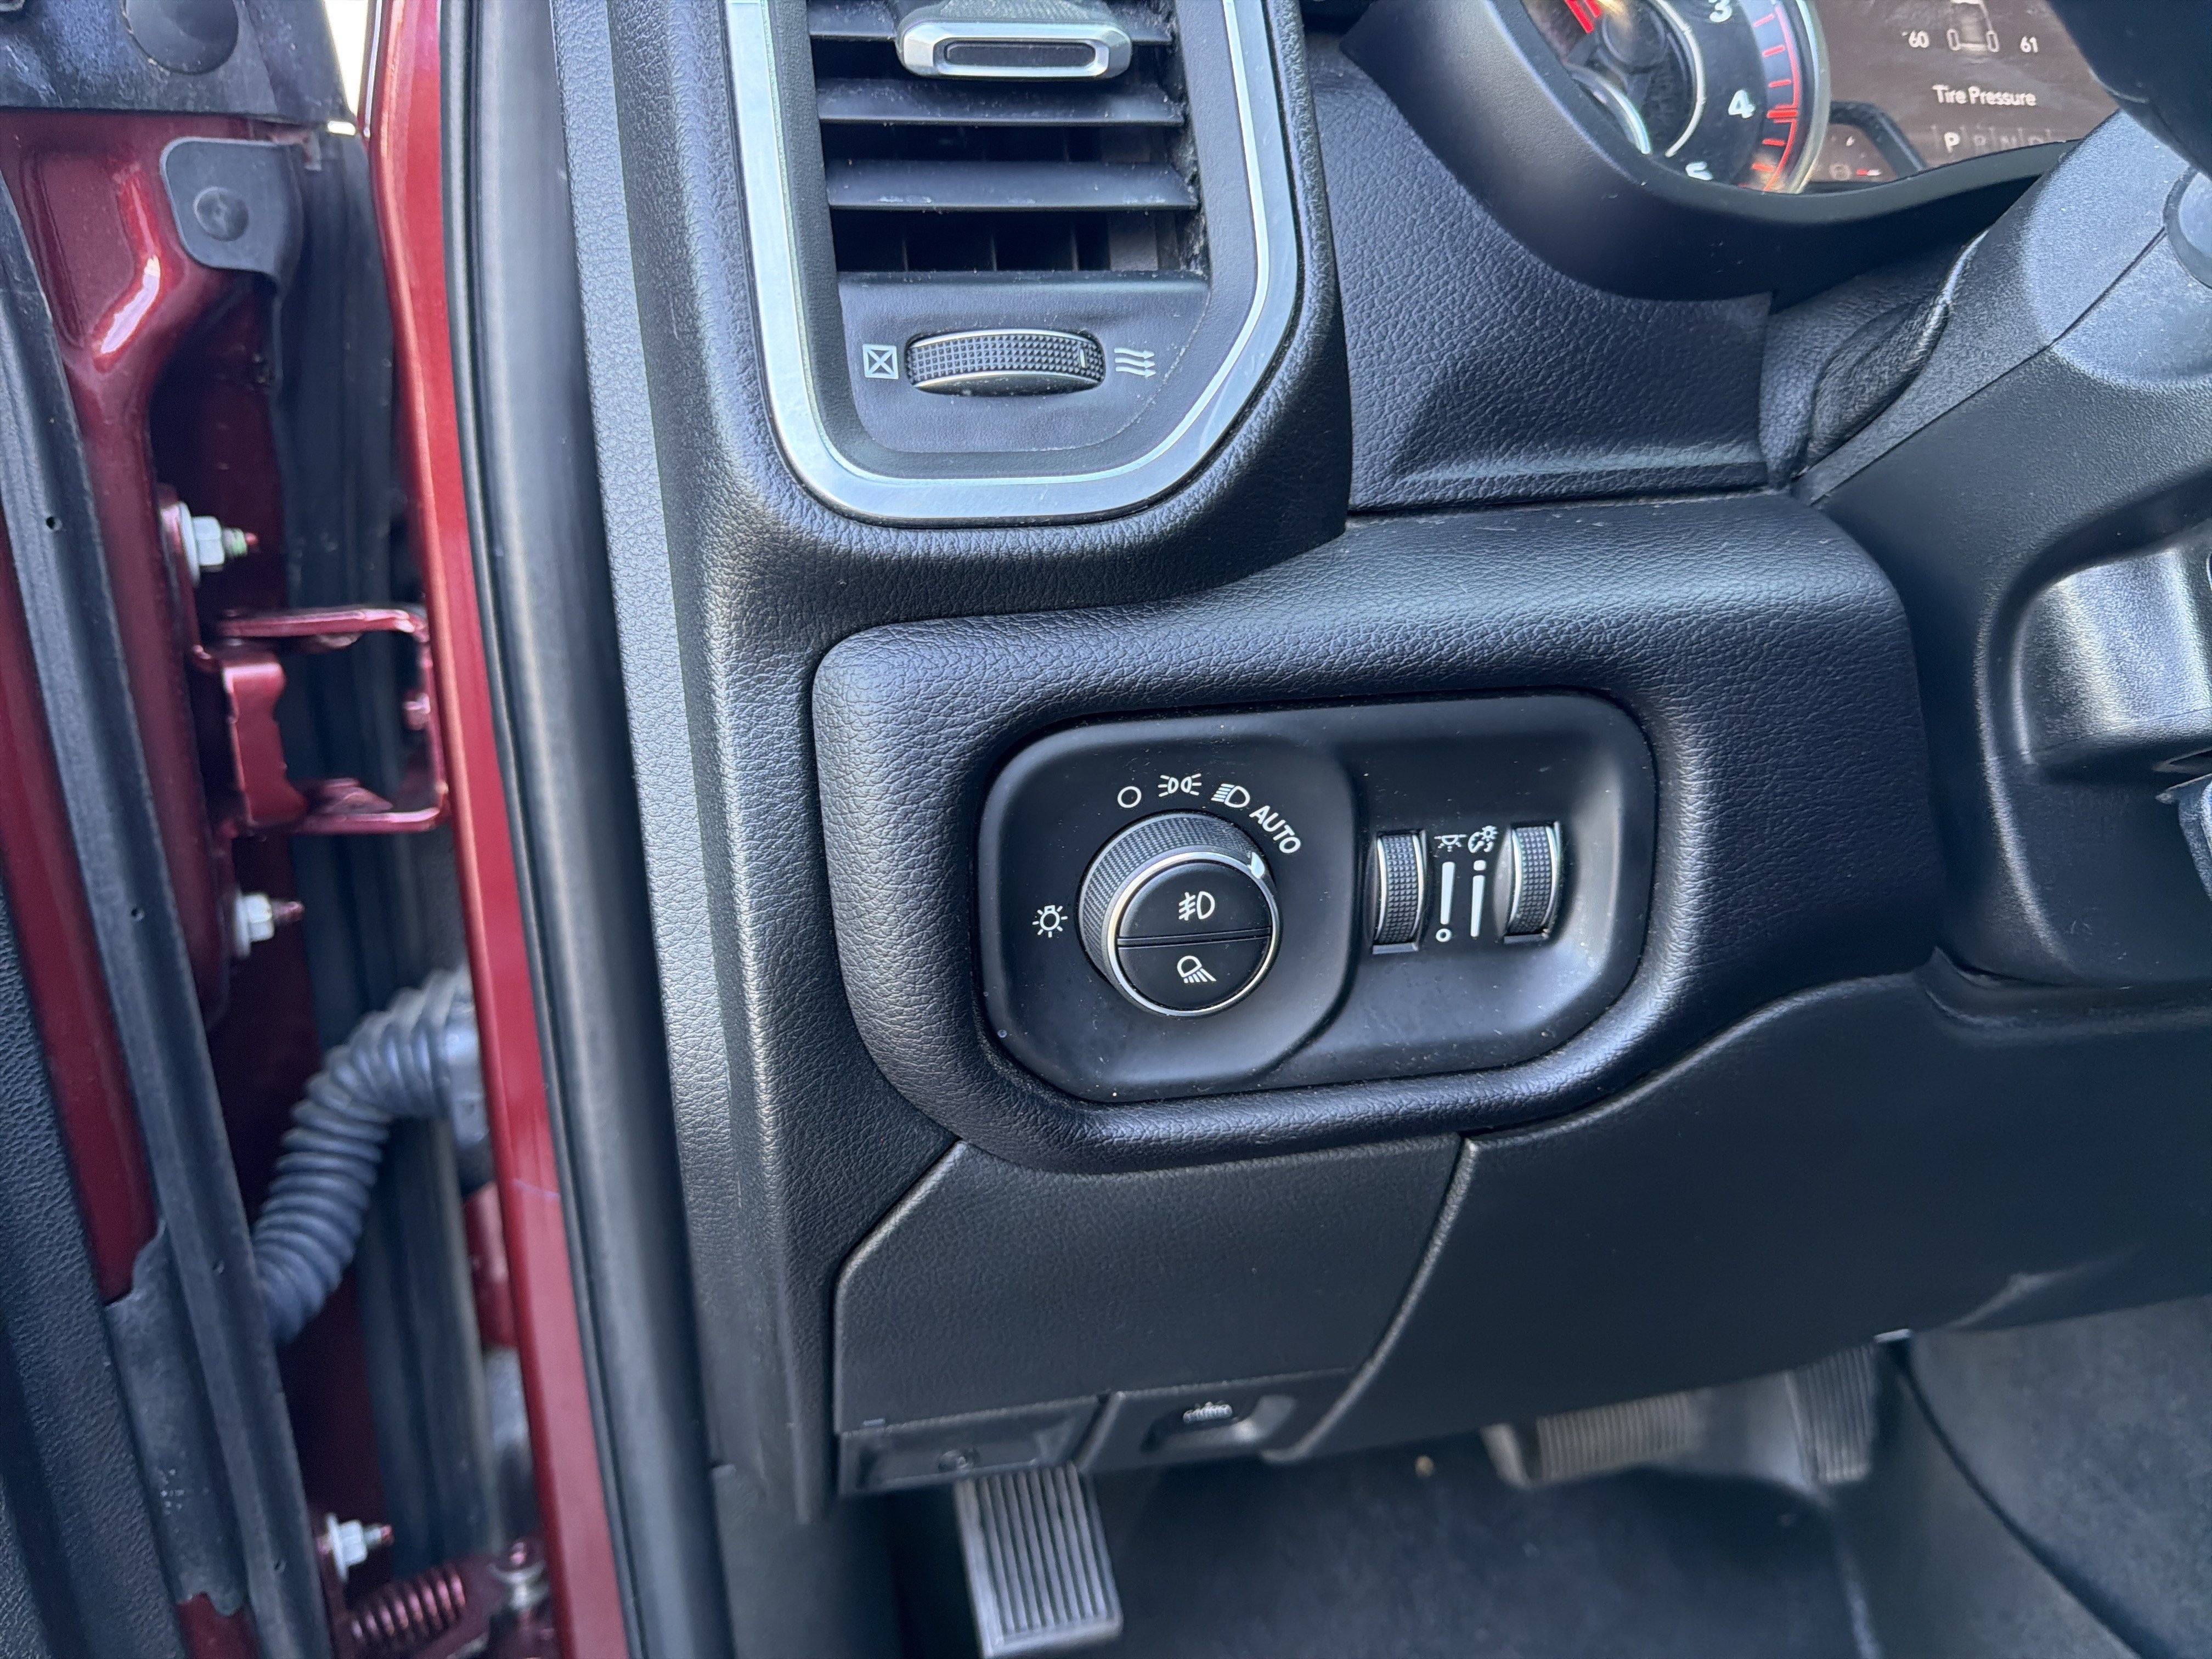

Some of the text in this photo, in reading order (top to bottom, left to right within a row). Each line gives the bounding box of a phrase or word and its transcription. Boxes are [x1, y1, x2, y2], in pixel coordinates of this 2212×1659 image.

[1908, 30, 1930, 48] 60
[2020, 36, 2039, 53] 61
[1728, 89, 1756, 119] 4
[1931, 84, 2037, 106] Tire Pressure
[1249, 805, 1301, 854] AUTO
